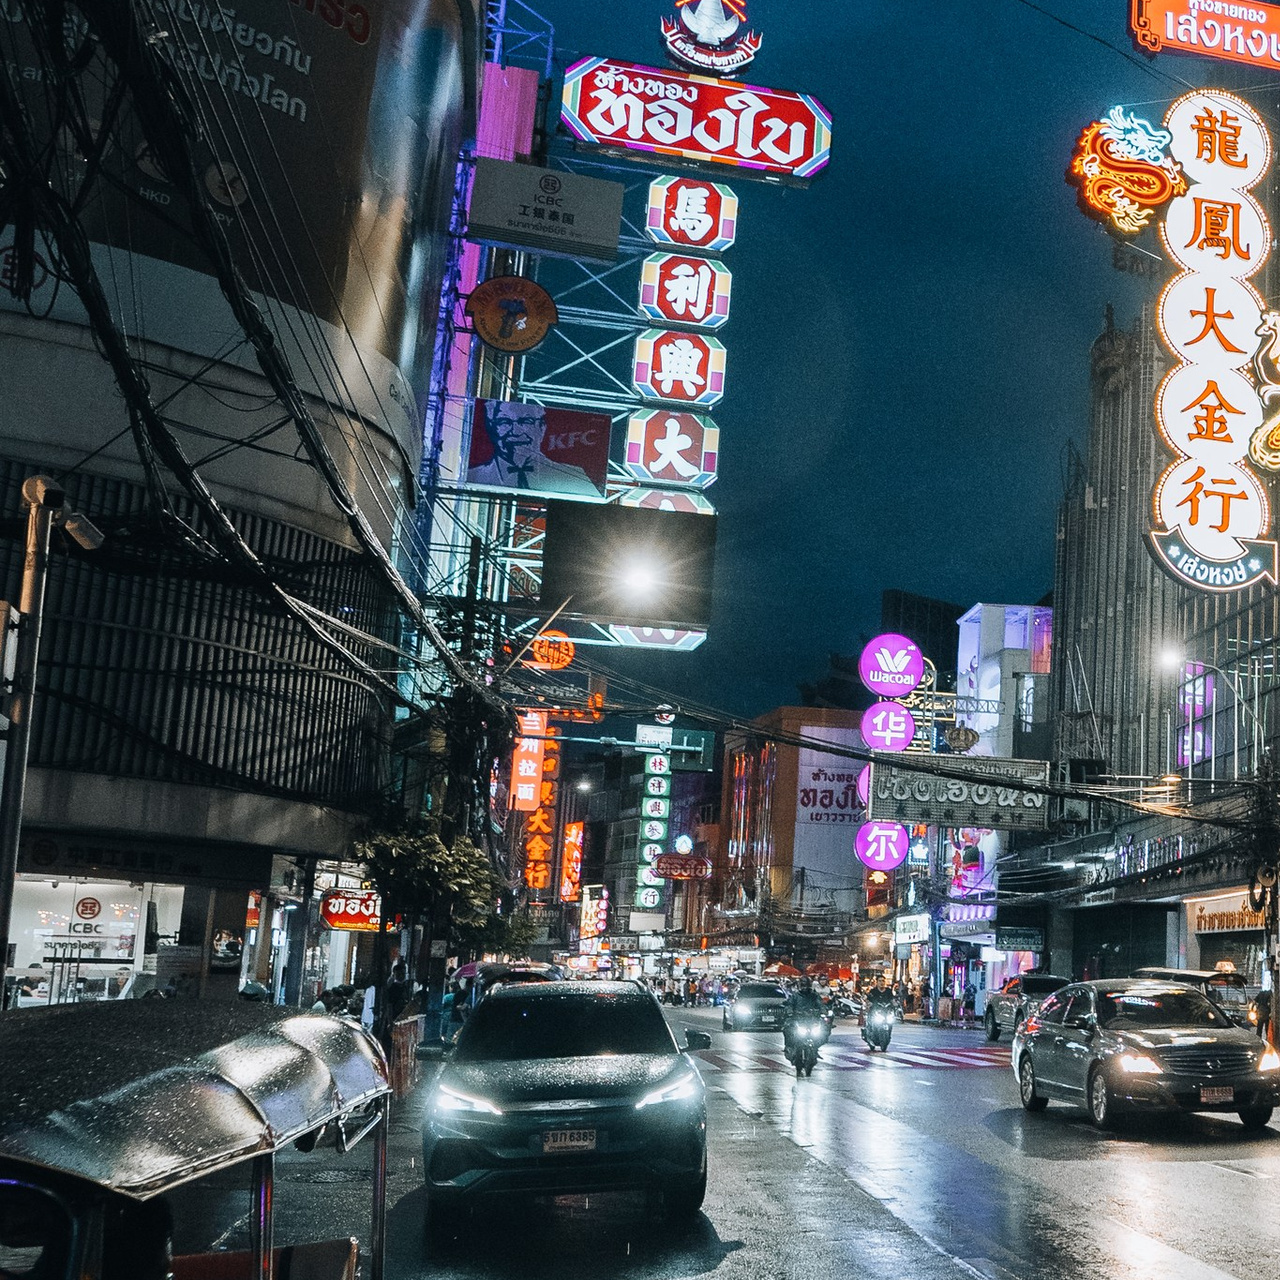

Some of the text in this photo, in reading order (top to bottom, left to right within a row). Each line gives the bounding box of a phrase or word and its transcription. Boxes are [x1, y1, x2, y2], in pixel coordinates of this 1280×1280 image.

[594, 65, 698, 104] ห้างทอง
[586, 87, 808, 164] ทองใบ
[139, 186, 171, 206] HKD
[534, 194, 563, 208] ICBC
[212, 210, 235, 227] PY
[1176, 107, 1250, 533] 龍鳳大金行
[549, 429, 597, 451] KFC
[1177, 550, 1246, 586] เล่งหงษ์
[869, 670, 914, 686] Wacoal
[811, 769, 858, 783] ห้างทอ
[328, 894, 381, 916] ทองใ
[68, 922, 105, 934] ICBC
